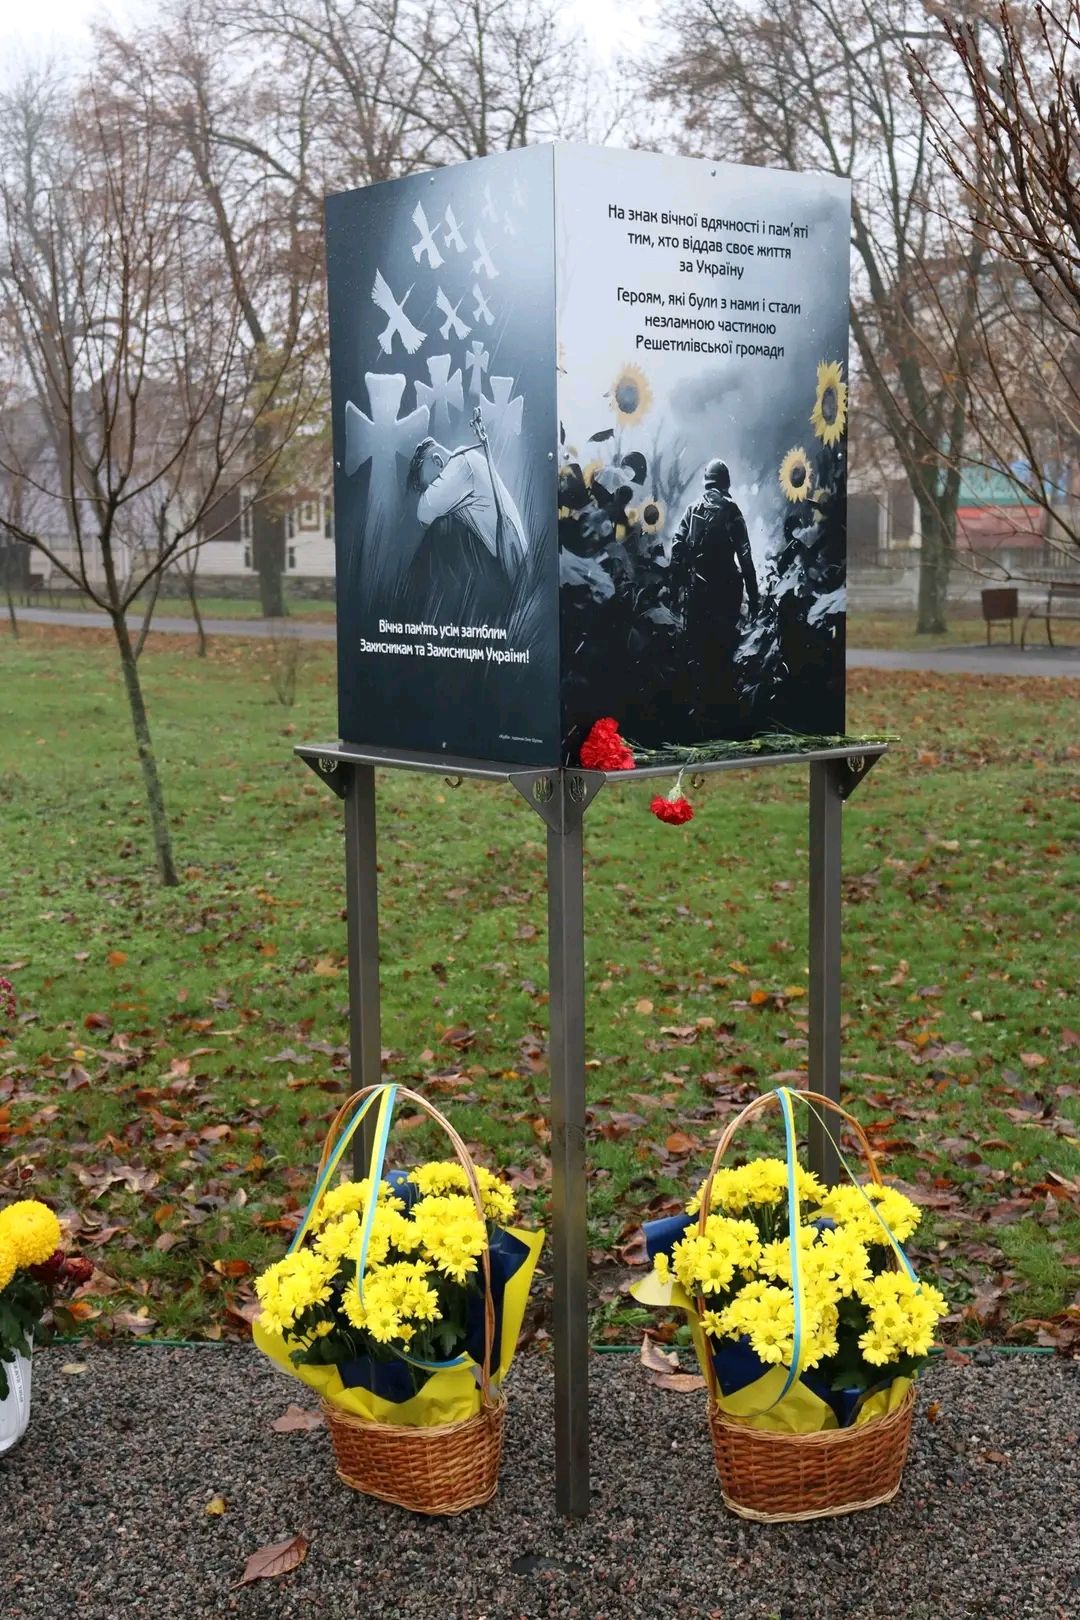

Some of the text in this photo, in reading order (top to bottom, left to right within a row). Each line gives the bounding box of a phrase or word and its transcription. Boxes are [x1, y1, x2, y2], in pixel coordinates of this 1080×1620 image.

[608, 204, 625, 219] На
[628, 209, 658, 223] знак
[661, 210, 698, 228] вічної
[701, 217, 759, 234] вдячності
[628, 233, 791, 258] тим, хто віддав своє життя
[680, 260, 744, 279] за Україну
[617, 288, 664, 306] Героям,
[668, 292, 685, 306] які
[689, 293, 718, 310] були
[721, 299, 726, 309] з
[730, 299, 759, 311] нами
[769, 301, 801, 314] стали
[645, 315, 776, 334] незламною частиною
[636, 335, 784, 359] Решетилівської громади
[379, 619, 403, 634] Вічна
[440, 623, 460, 639] усім
[462, 625, 506, 639] загиблим
[360, 639, 529, 664] Захисникам та Захисницям України!
